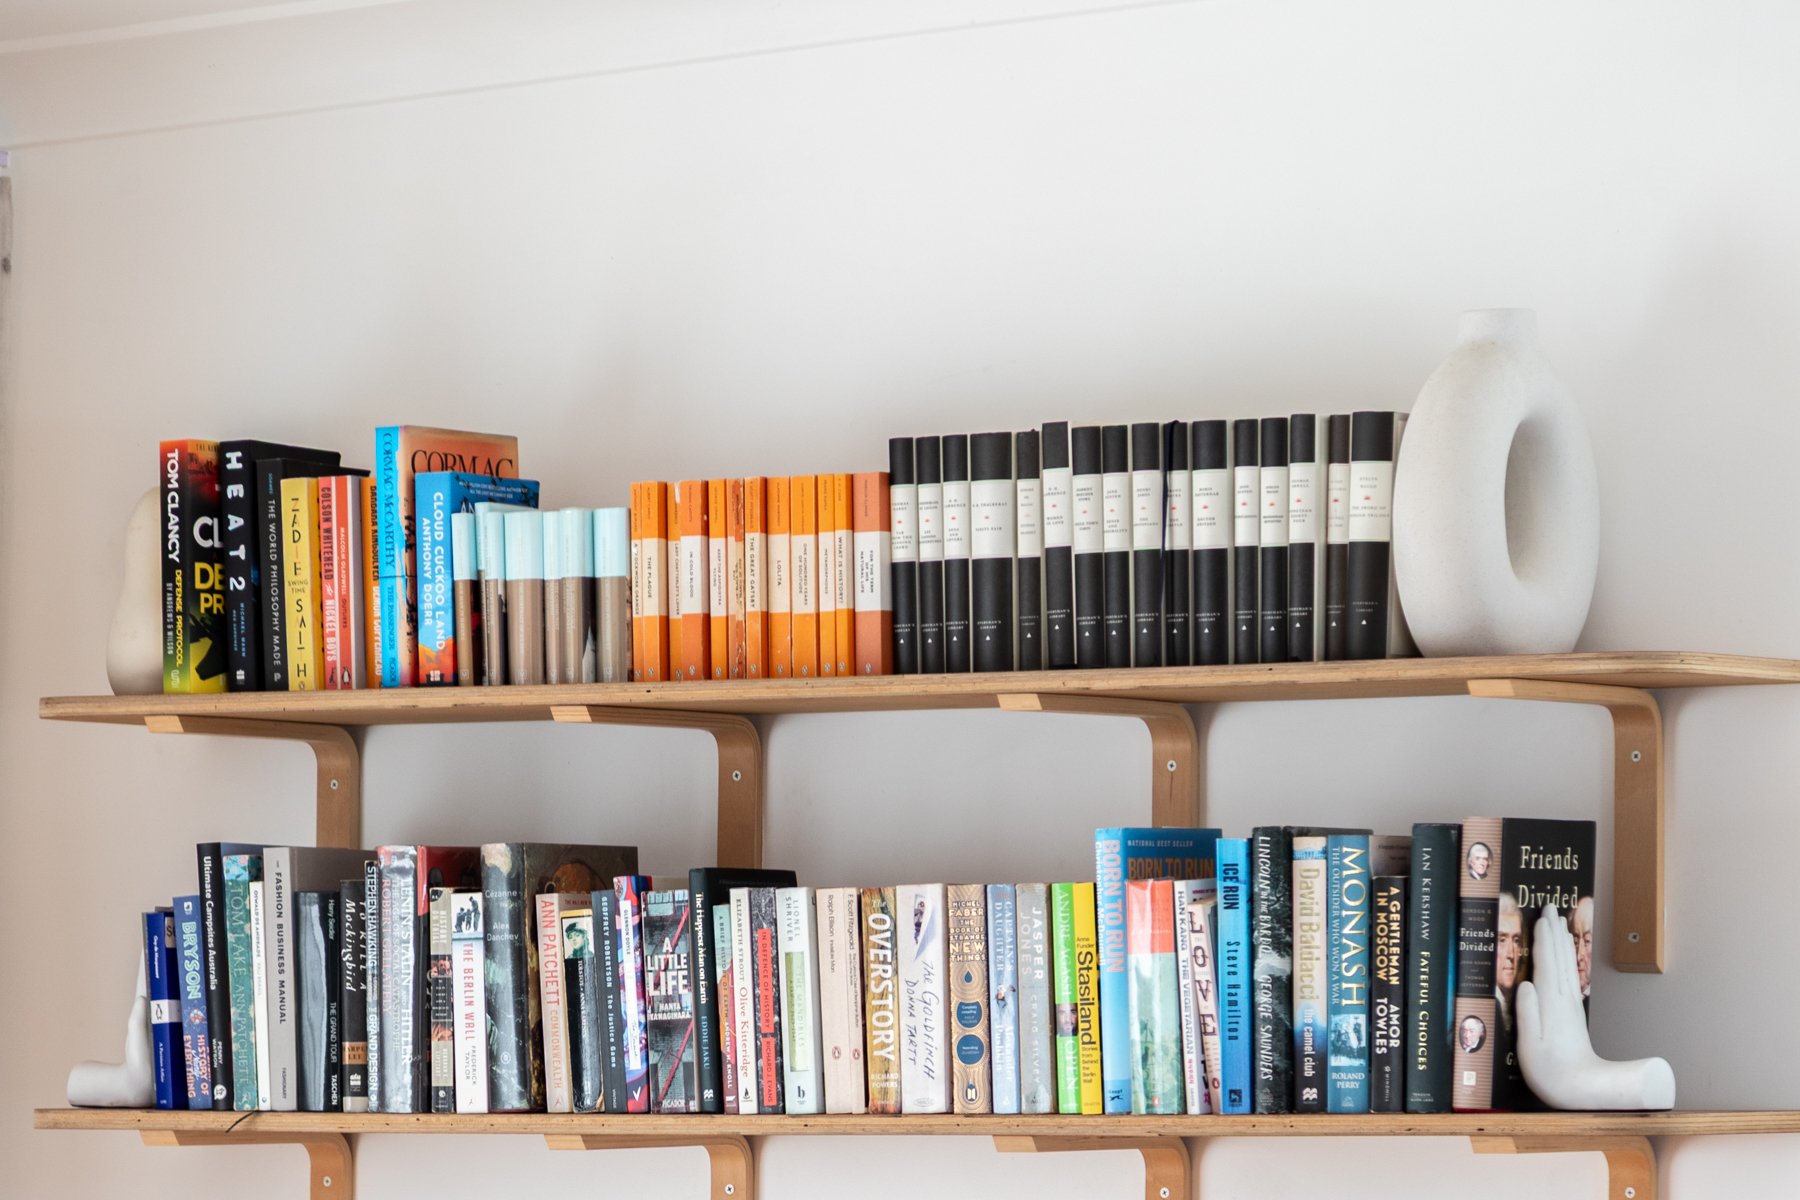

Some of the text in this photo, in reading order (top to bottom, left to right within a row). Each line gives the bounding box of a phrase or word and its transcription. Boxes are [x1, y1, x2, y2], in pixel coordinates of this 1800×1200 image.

[383, 432, 393, 489] CORMAC
[167, 448, 180, 563] TOM CLANCY
[225, 451, 246, 591] HEAT 2
[321, 487, 333, 523] COLSON
[269, 523, 278, 561] WORLD
[291, 498, 302, 576] ZADIE
[323, 528, 334, 580] WHITEHEAD
[839, 560, 843, 568] IS
[270, 565, 280, 631] PHILOSOPHY
[422, 518, 433, 625] ANTHONY DOERR
[433, 492, 446, 650] CLOUD CUCKOO LAND
[325, 600, 337, 633] NICKEL
[273, 635, 281, 665] MADE
[327, 637, 336, 661] BOYS
[1223, 863, 1240, 910] ICE RUN
[1519, 846, 1579, 871] Friends
[204, 855, 217, 991] Ultimate Campsites Australia
[485, 889, 517, 899] Cézanne
[785, 897, 793, 942] SHRIVER
[949, 908, 984, 918] FABER
[1103, 839, 1124, 973] BORN TO RUN
[1517, 885, 1579, 909] Divided
[274, 872, 286, 1024] FASHION BUSINESS MANUAL
[341, 899, 356, 991] Mockingbird
[486, 932, 519, 942] Danchev
[540, 900, 560, 1006] ANN PATCHETT
[950, 941, 986, 953] NEW
[1020, 912, 1031, 976] JONES
[1032, 907, 1044, 980] JASPER
[1299, 868, 1321, 1000] David Baldacci
[1342, 846, 1367, 1007] MONASH
[1376, 892, 1388, 980] IN MOSCOW
[1459, 942, 1495, 952] Divided
[1460, 927, 1495, 938] Friends
[182, 921, 201, 1000] BRYSON
[367, 866, 378, 1091] STEPHEN HAWKING GRAND DESIGN
[647, 953, 688, 972] LITTLE
[647, 970, 689, 997] LIFE
[868, 913, 895, 1061] OVERSTORY
[951, 954, 986, 962] THINGS
[1418, 847, 1432, 1071] IAN KERSHAW FATEFUL CHOICES
[462, 943, 475, 1040] THE BERLIN WALL
[649, 1011, 691, 1021] YANAGIHARA
[1078, 951, 1098, 1046] Stasiland
[1227, 941, 1241, 1041] Steve Hamilton
[550, 1009, 561, 1089] COMMONWEALTH
[739, 987, 750, 1078] Olive Kitteridge
[1376, 997, 1388, 1055] TOWLES
[1389, 1004, 1400, 1048] AMOR
[184, 1035, 196, 1098] EVERYTHING
[702, 1046, 710, 1070] JAKU
[1331, 1072, 1366, 1080] ROLAND
[1336, 1081, 1361, 1089] PERRY
